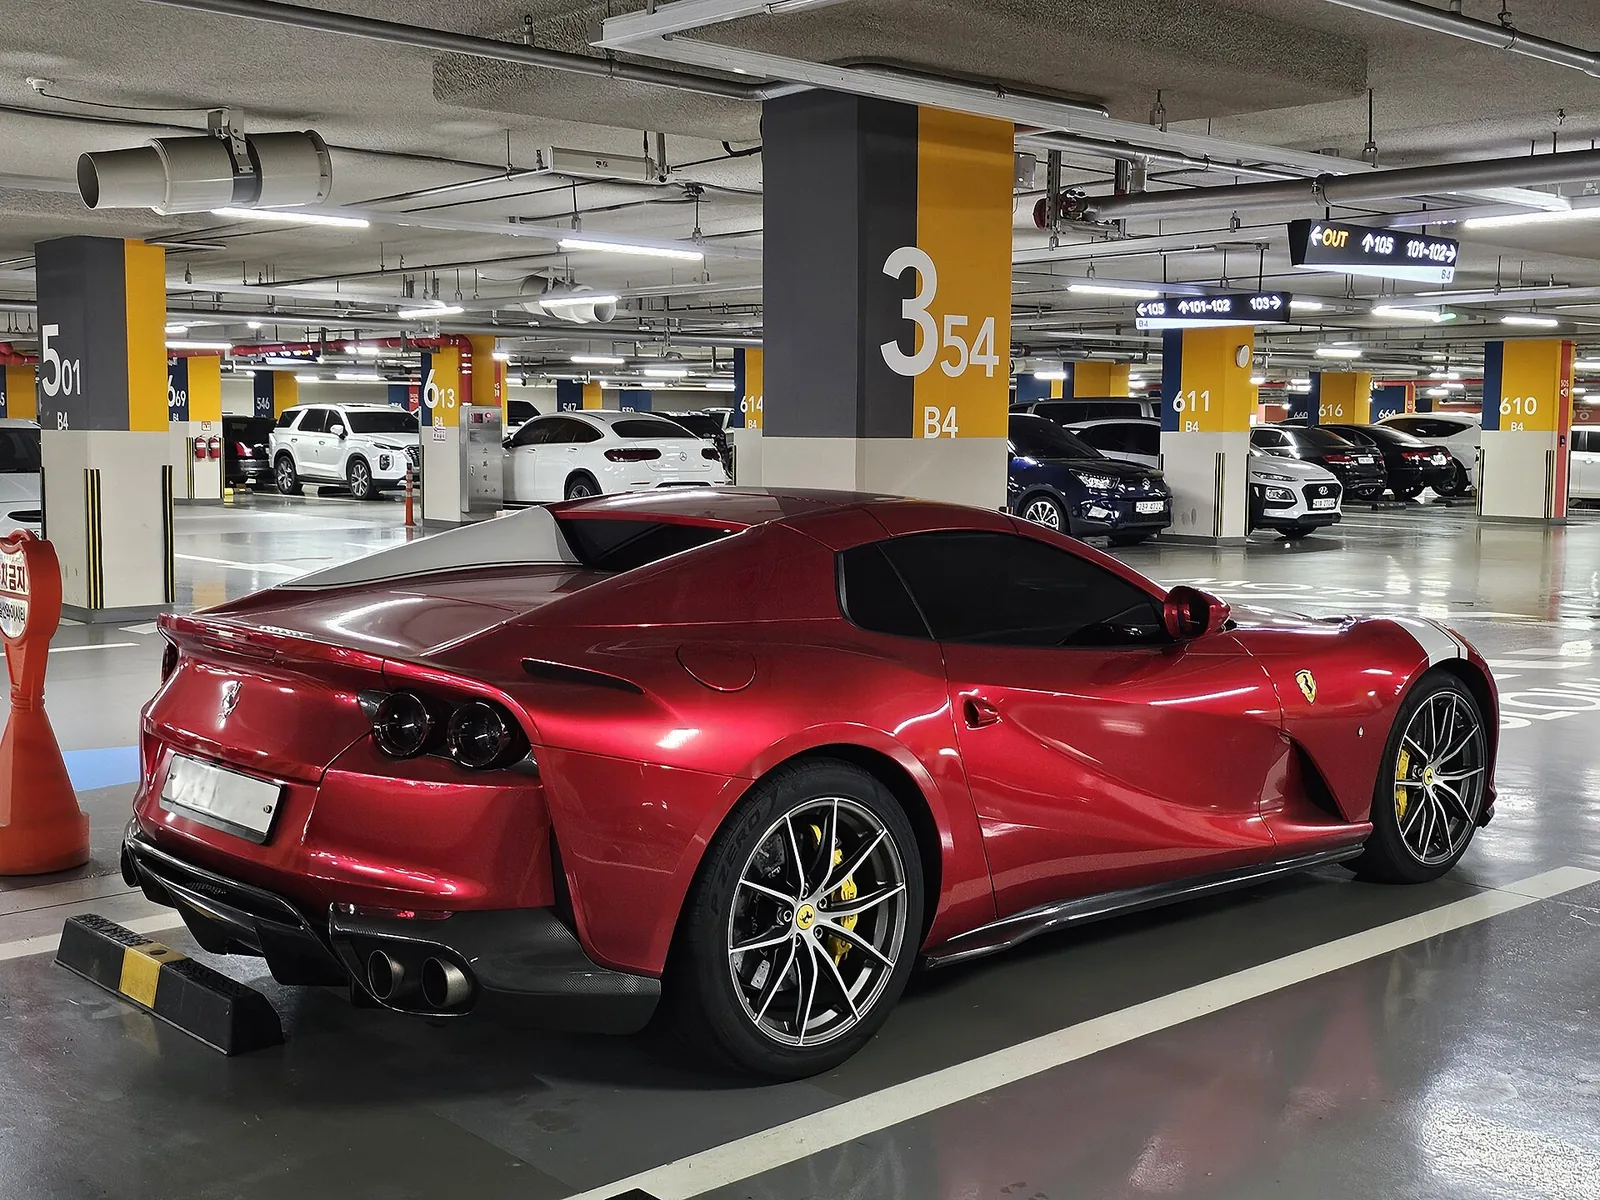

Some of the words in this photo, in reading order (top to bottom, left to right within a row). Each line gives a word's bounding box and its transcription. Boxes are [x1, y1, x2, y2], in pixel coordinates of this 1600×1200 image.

[1322, 229, 1349, 248] OUT
[1374, 236, 1394, 254] 105
[1406, 239, 1447, 261] 101-102
[1147, 303, 1165, 316] 105
[1189, 299, 1231, 313] 101-102
[1250, 297, 1270, 310] 103
[423, 369, 455, 409] 613
[256, 397, 270, 410] 546
[740, 395, 763, 413] 614
[1172, 390, 1210, 413] 611
[1318, 404, 1344, 417] 616
[1499, 397, 1537, 416] 610
[57, 411, 69, 431] B4
[434, 416, 444, 427] B4
[923, 406, 959, 439] B4
[1185, 420, 1200, 433] B4
[1510, 421, 1525, 432] B4
[0, 562, 26, 592] 차금지
